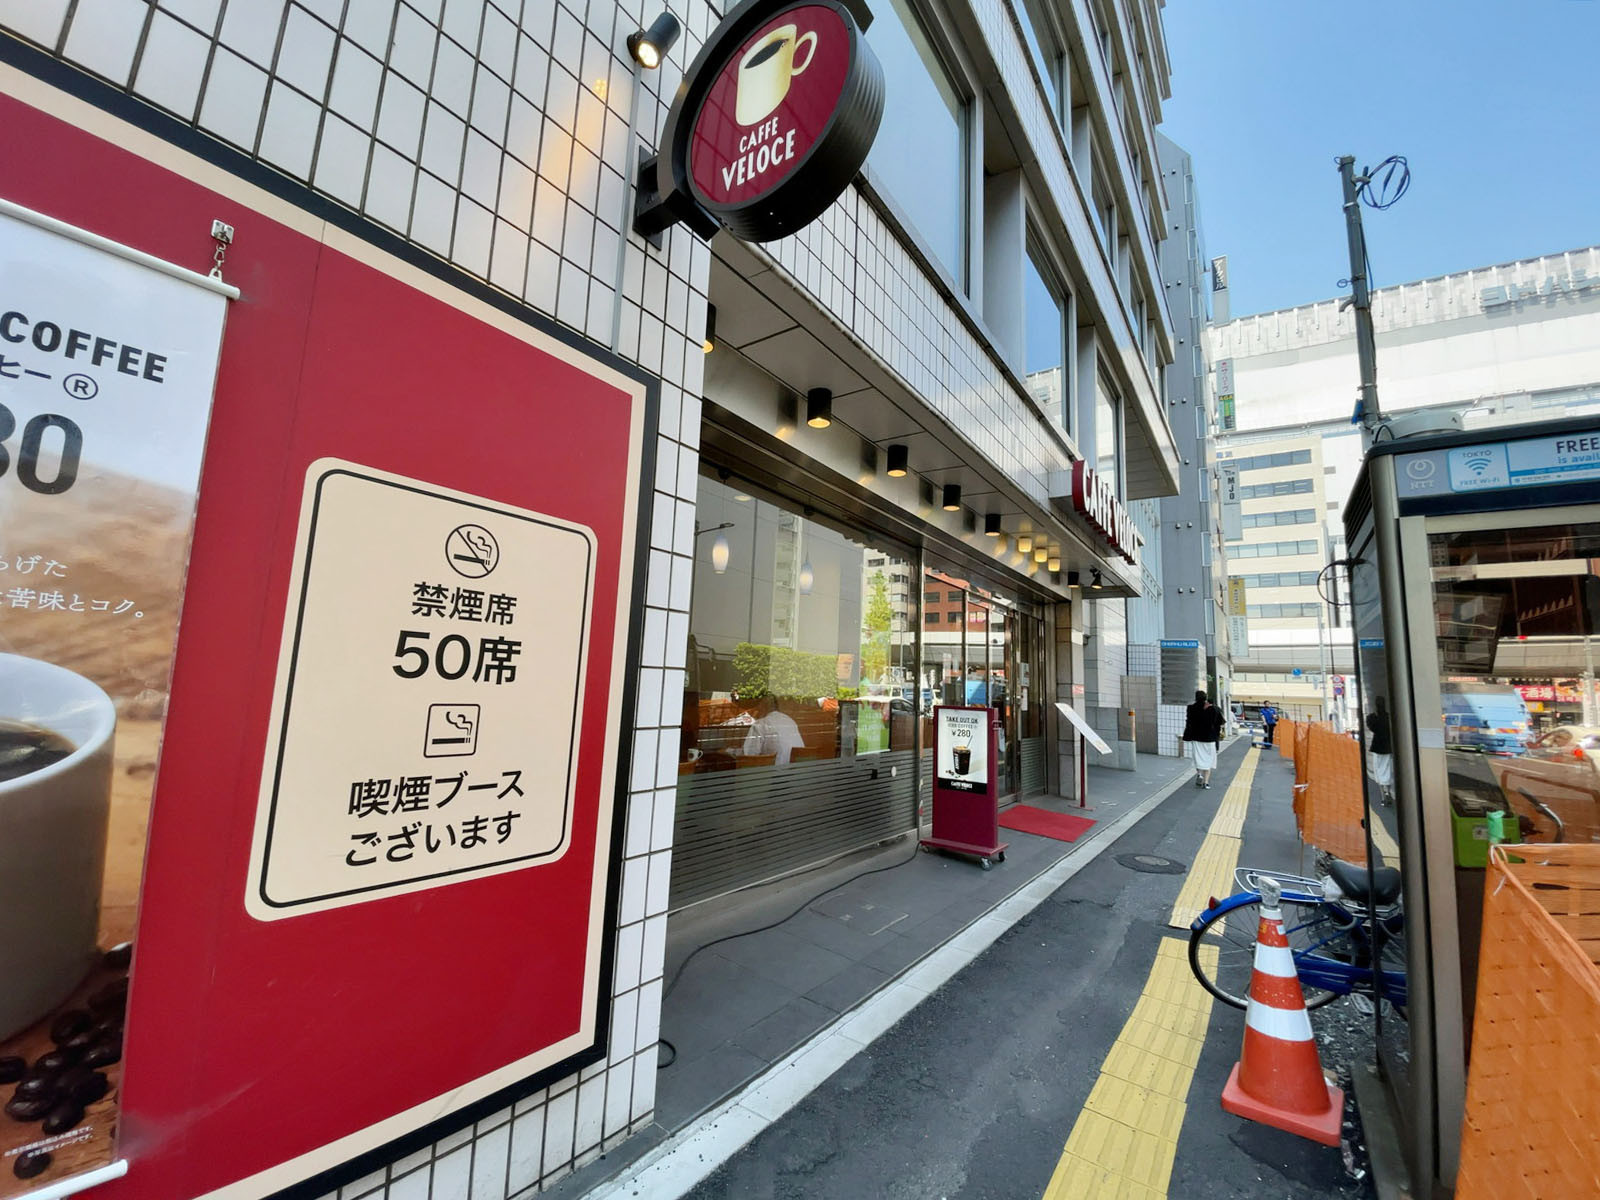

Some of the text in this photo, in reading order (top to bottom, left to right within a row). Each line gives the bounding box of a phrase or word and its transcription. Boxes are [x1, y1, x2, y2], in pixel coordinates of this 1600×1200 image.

[739, 116, 779, 154] CAFFE
[722, 128, 796, 192] VELOCE
[0, 311, 168, 384] COFFEE
[1463, 449, 1492, 457] TOKYO
[1556, 437, 1600, 454] FREE
[1557, 456, 1567, 464] is
[1410, 479, 1435, 490] NTT
[0, 587, 144, 619] 苦味とコク。
[412, 581, 517, 626] 禁煙席
[392, 630, 522, 686] 50席
[348, 769, 525, 818] 喫煙ブース
[345, 811, 521, 868] ございます
